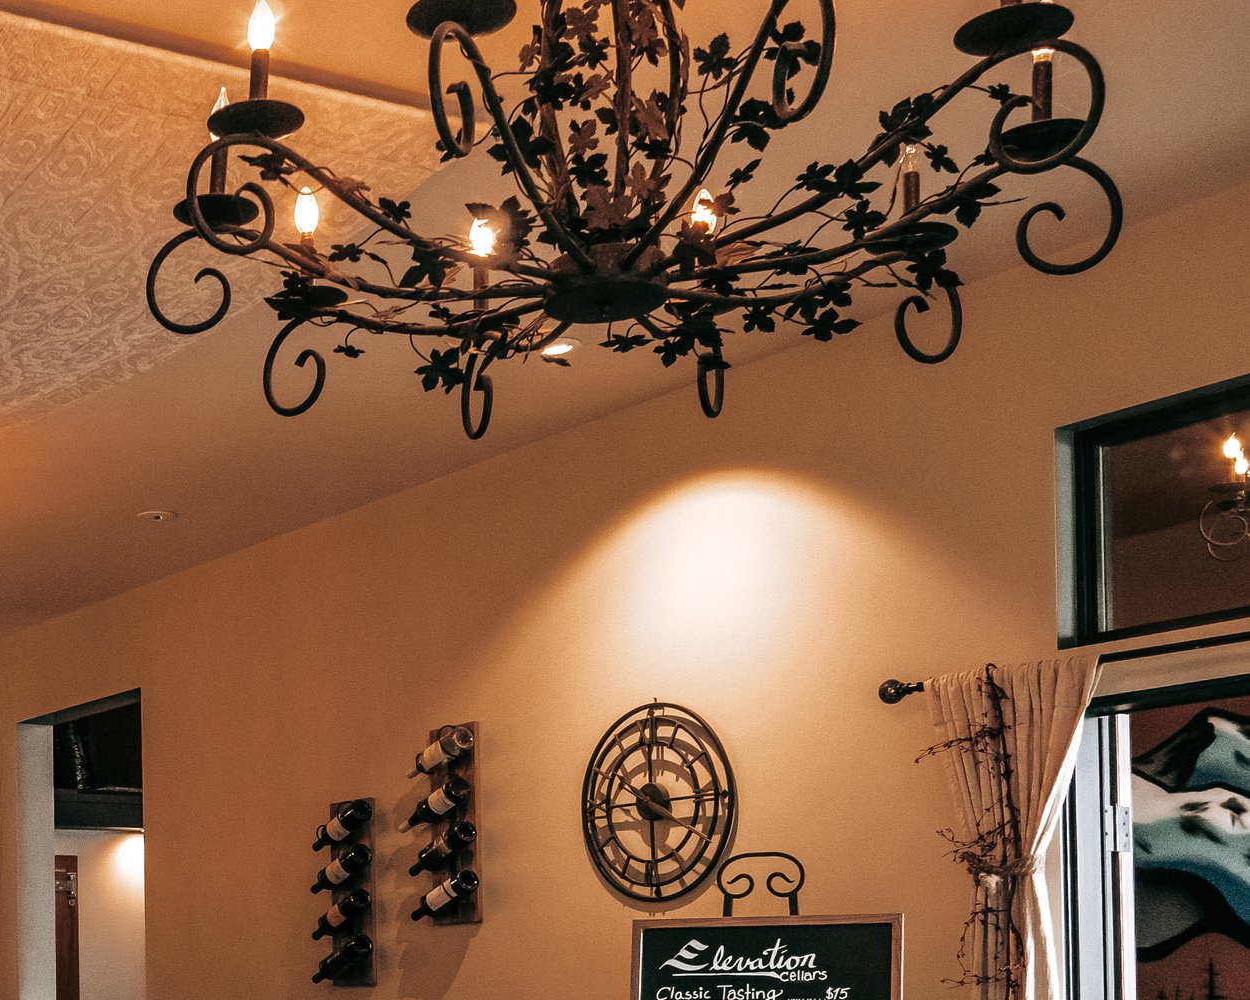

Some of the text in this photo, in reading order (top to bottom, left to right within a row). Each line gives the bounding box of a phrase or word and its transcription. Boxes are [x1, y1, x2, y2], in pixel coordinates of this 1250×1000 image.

[658, 938, 817, 971] Elevation
[779, 970, 828, 982] cellars
[655, 986, 711, 1000] Classic
[825, 987, 851, 1000] $15
